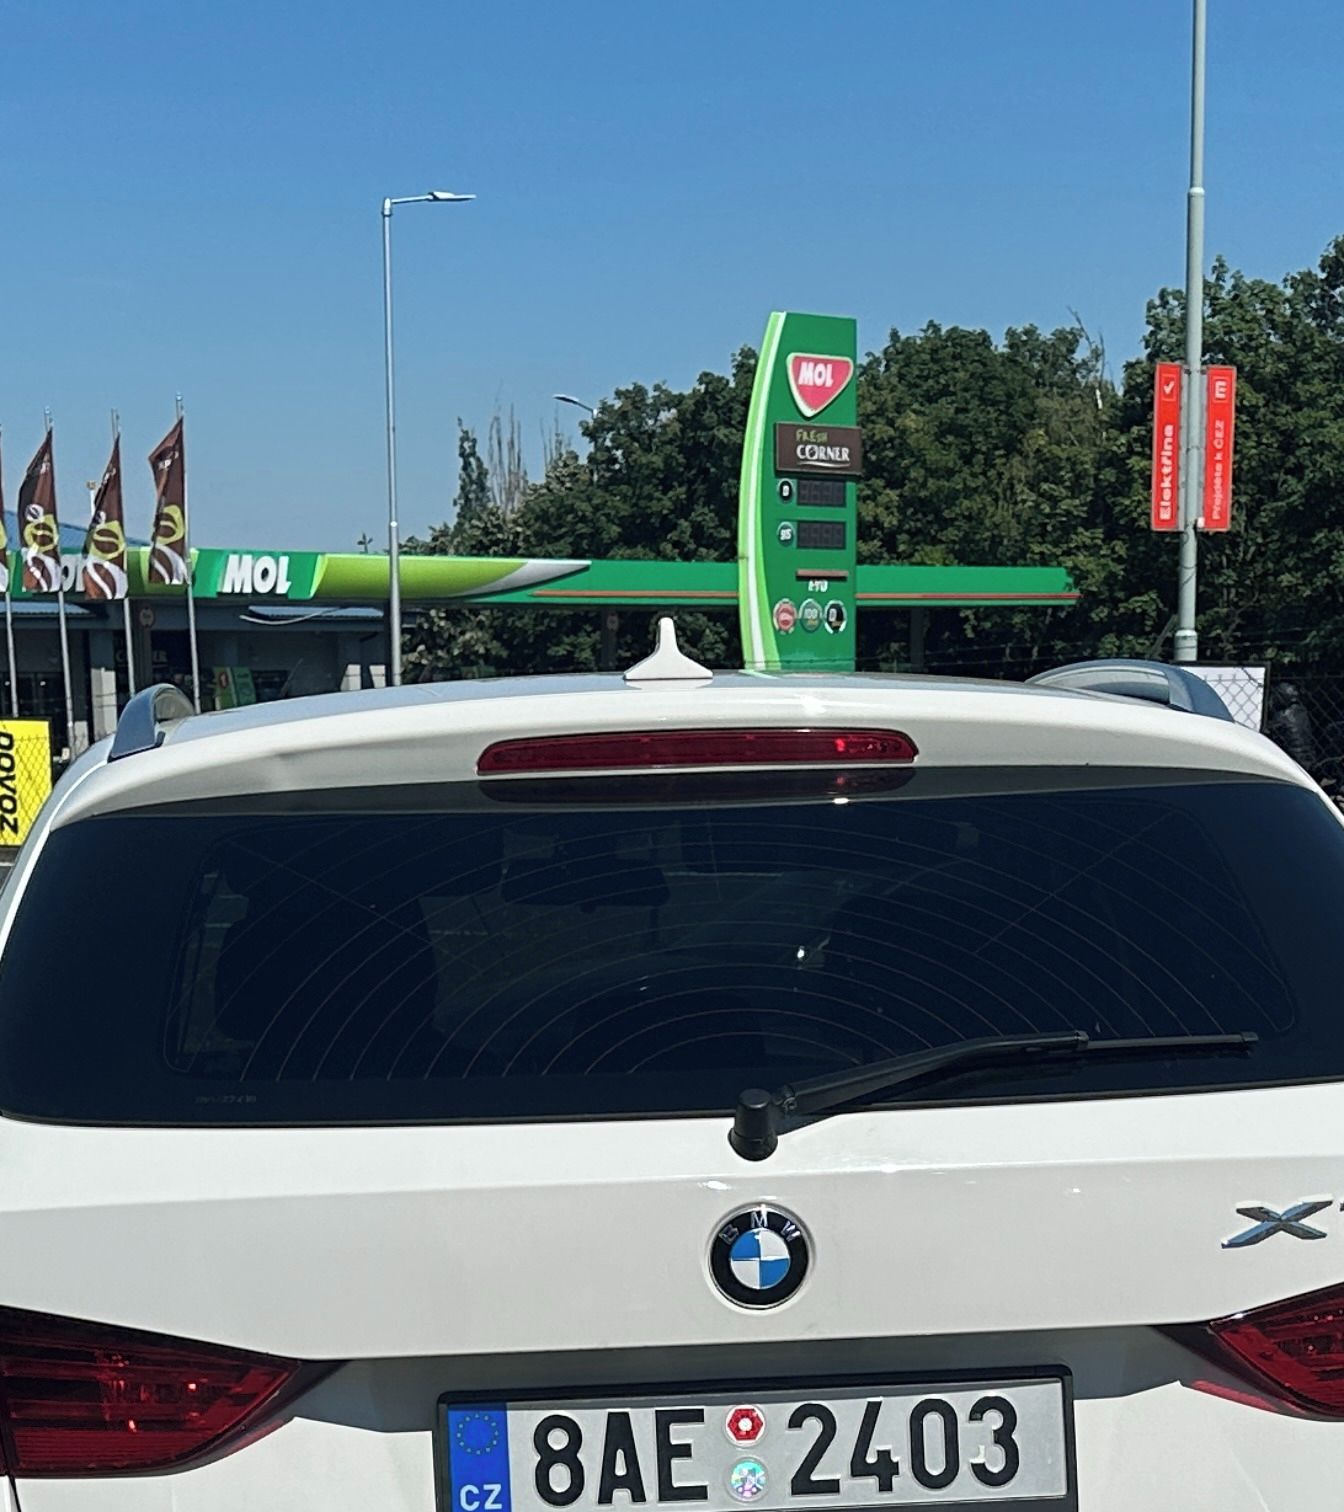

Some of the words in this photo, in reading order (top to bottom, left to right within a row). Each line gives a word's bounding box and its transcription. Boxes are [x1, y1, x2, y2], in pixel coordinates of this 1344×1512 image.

[798, 361, 834, 388] MOL
[796, 444, 850, 462] CORNER
[1159, 424, 1174, 520] Elektřina
[220, 553, 293, 595] MOL
[718, 1204, 802, 1246] BMW
[533, 1408, 709, 1508] 8AE
[787, 1395, 1020, 1497] 2403
[459, 1483, 504, 1512] CZ
